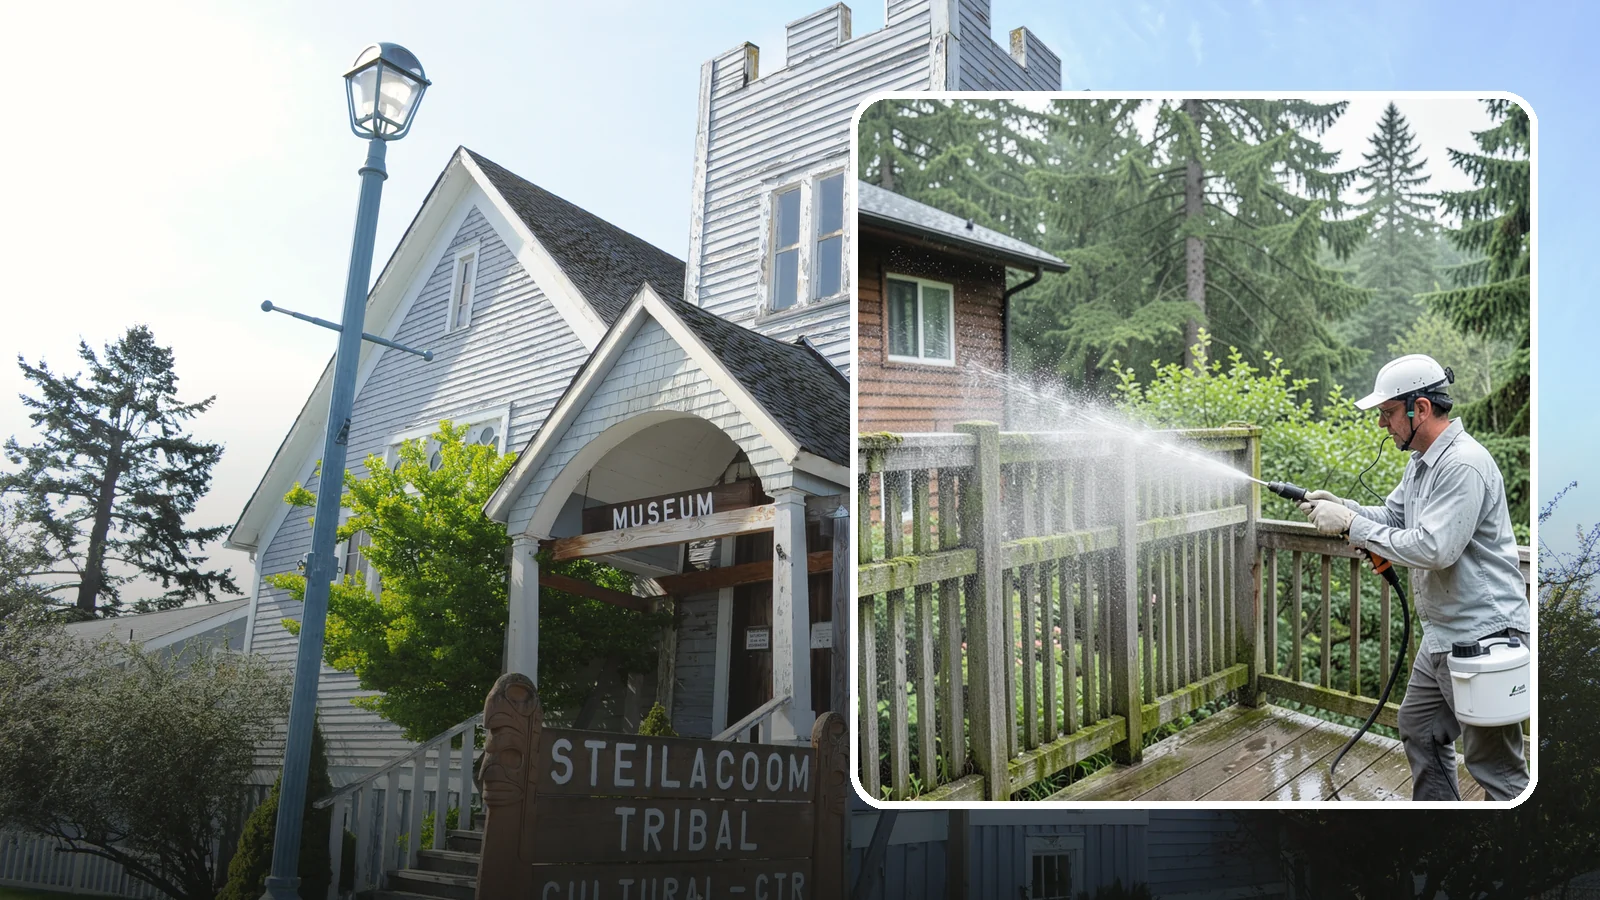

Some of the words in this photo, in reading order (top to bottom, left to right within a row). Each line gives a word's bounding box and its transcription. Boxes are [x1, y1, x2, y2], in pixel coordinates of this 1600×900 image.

[612, 491, 713, 531] MUSEUM
[550, 738, 810, 793] STEILACOOM
[614, 806, 757, 852] TRIBAL
